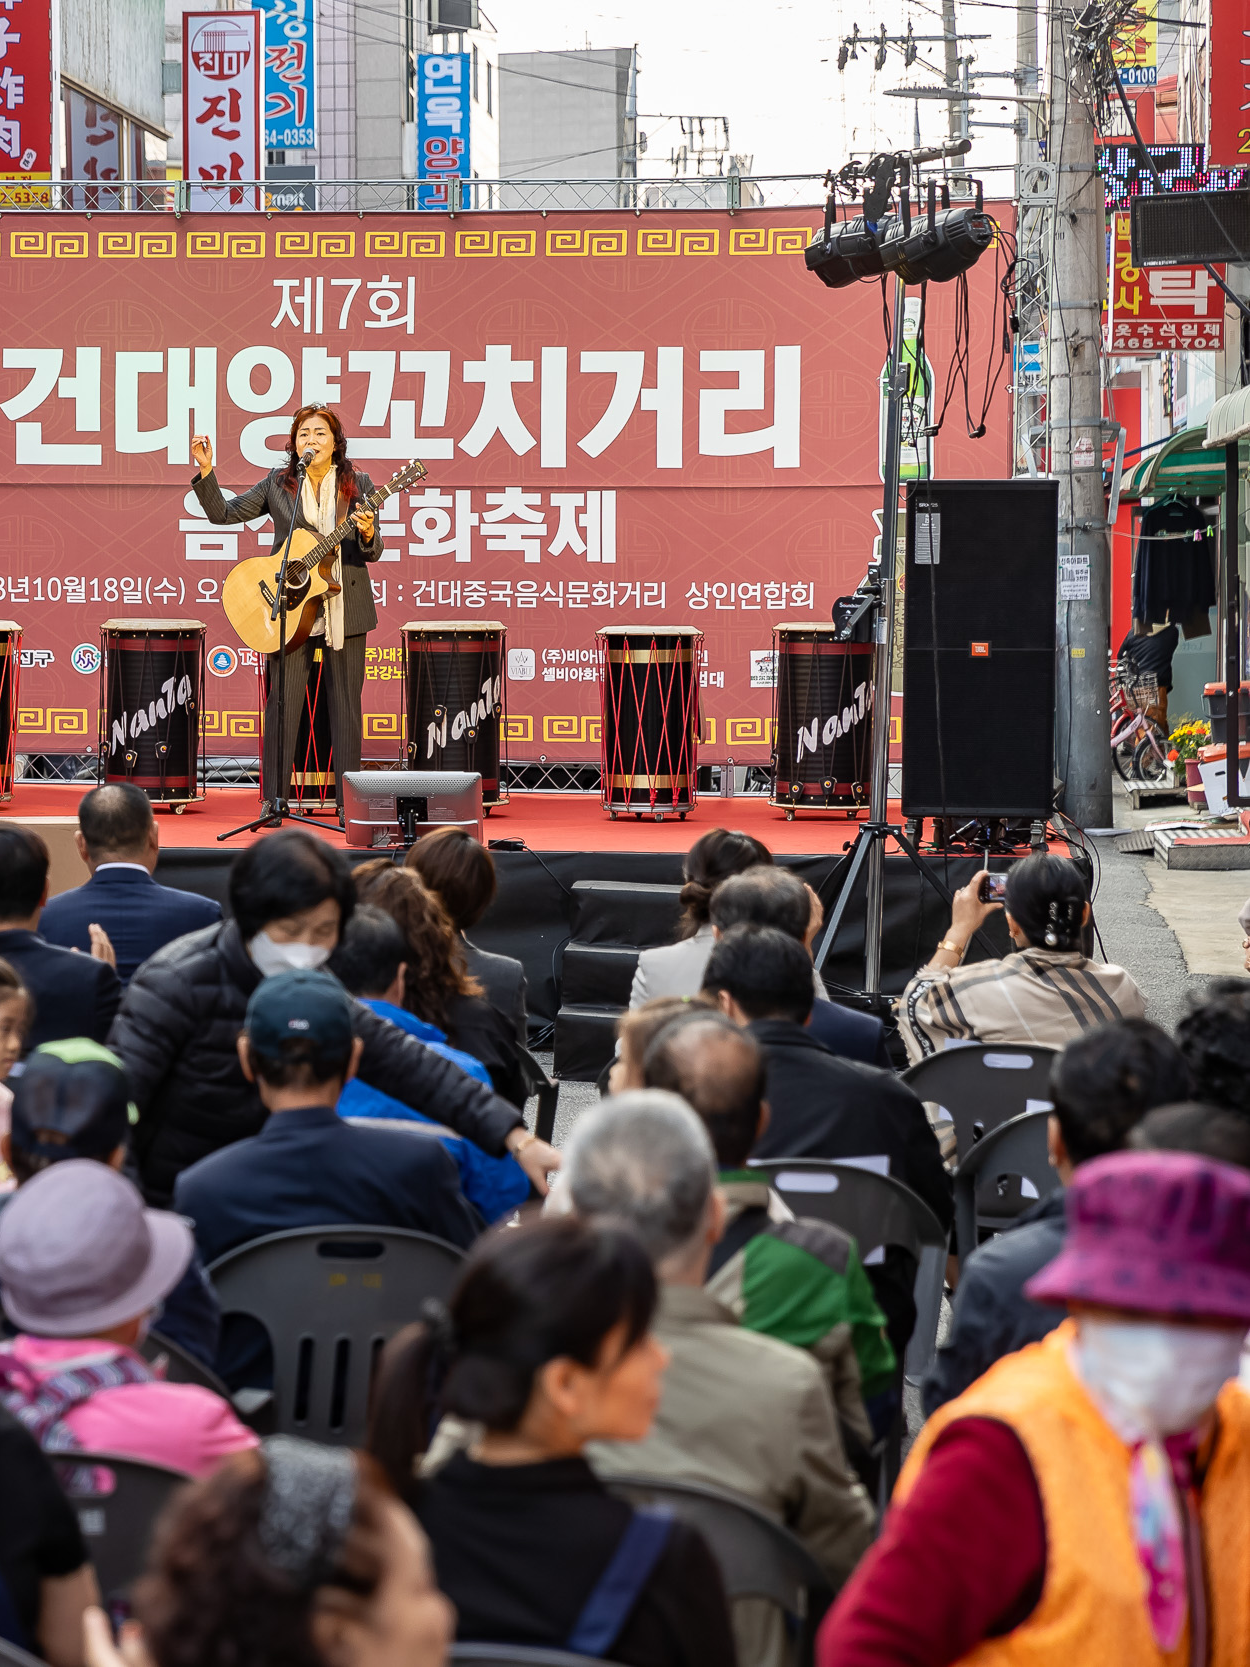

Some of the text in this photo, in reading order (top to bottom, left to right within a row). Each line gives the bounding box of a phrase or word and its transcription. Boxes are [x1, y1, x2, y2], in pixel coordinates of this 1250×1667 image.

[199, 52, 245, 76] 진미
[265, 128, 313, 146] 64-0353
[271, 275, 416, 335] 제7회
[1113, 338, 1221, 350] 465-1704
[0, 344, 801, 470] 건대양꼬치거리
[179, 486, 617, 564] 음화축제
[194, 577, 222, 604] 오
[412, 579, 666, 608] 건대중국음식문화거리
[684, 580, 815, 610] 상인연합회
[541, 648, 607, 664] (주)비아
[365, 666, 407, 680] 단강노
[541, 667, 605, 682] 셀비아화
